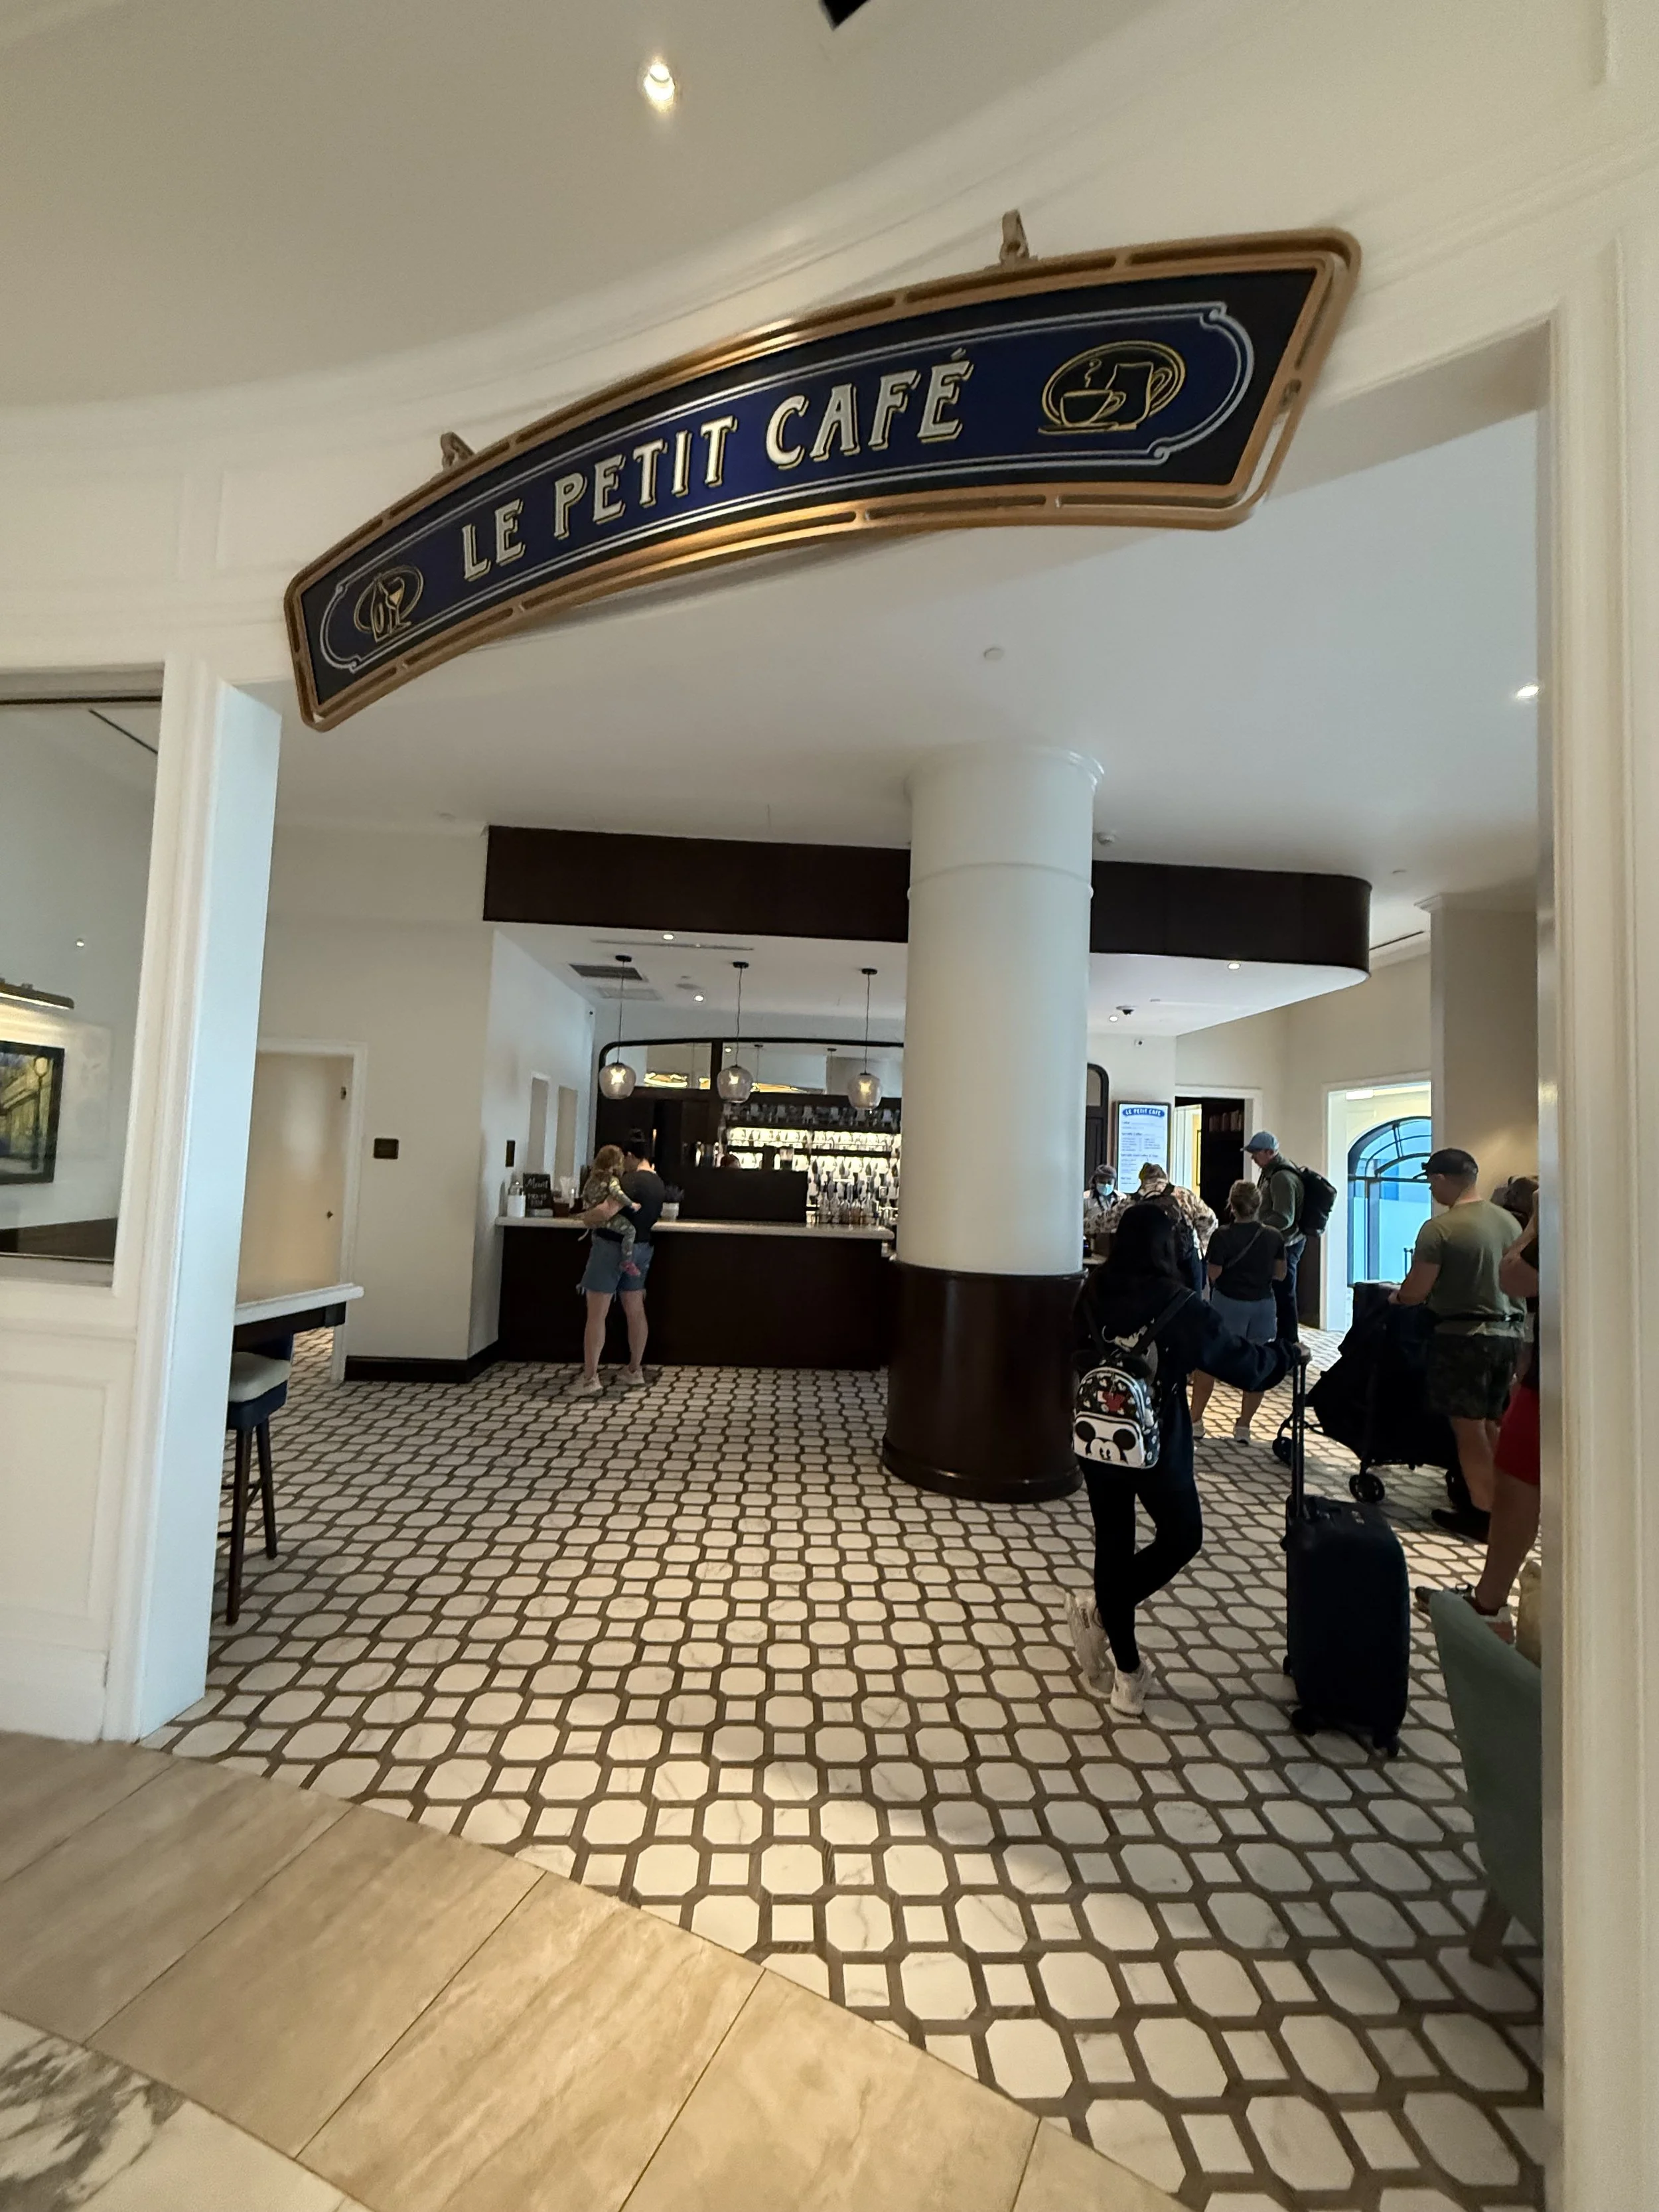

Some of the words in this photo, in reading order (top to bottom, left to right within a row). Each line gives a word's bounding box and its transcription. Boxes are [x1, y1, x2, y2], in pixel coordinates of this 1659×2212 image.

[462, 498, 526, 582] LE
[553, 415, 738, 540] PETIT
[766, 348, 974, 471] CAFÉ
